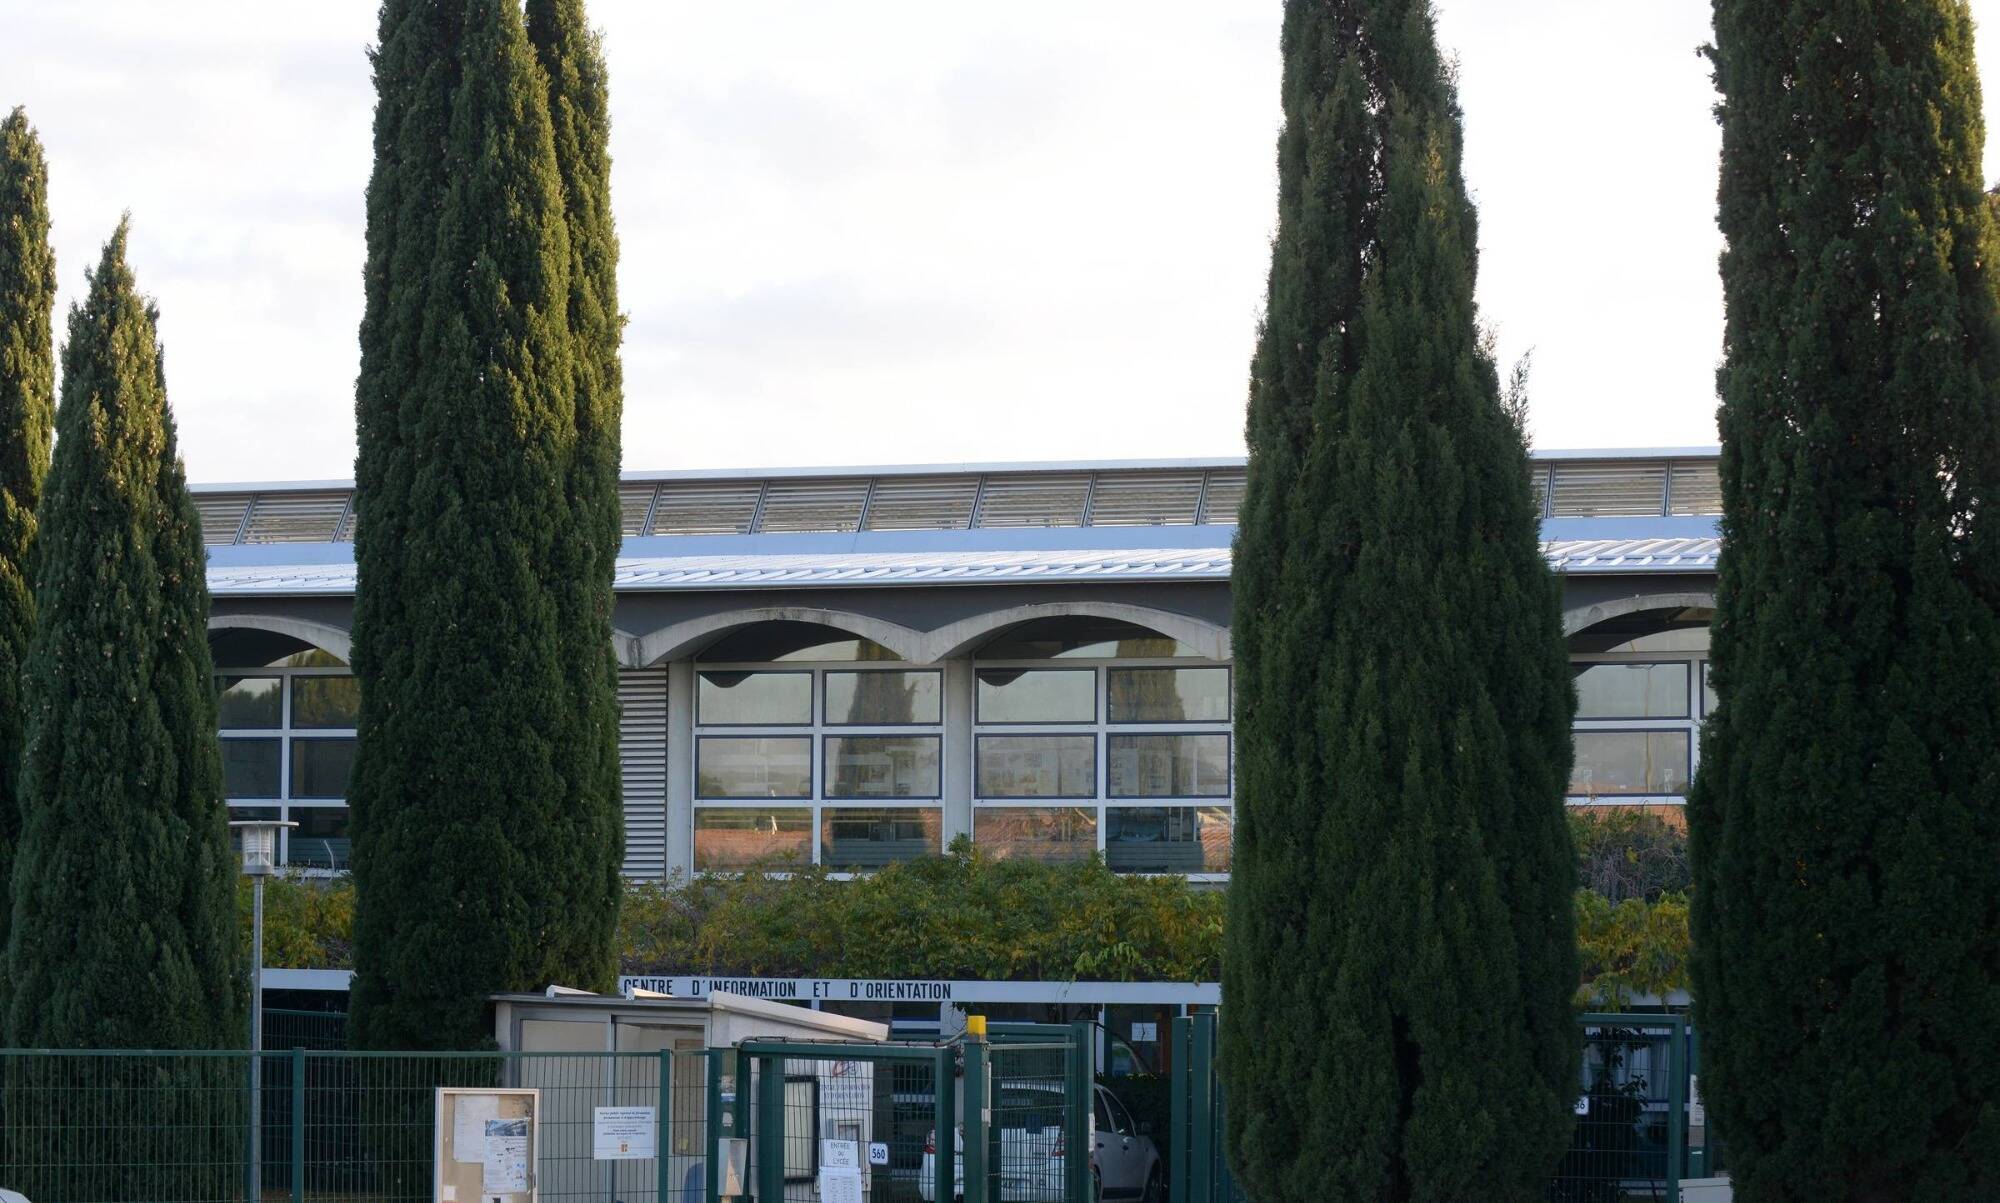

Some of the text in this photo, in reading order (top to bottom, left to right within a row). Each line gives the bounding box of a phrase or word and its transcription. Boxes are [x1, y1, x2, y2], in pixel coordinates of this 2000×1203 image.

[623, 978, 951, 999] CENTRE D'INFORMATION ET D'ORIENTATION
[871, 1147, 886, 1160] 560
